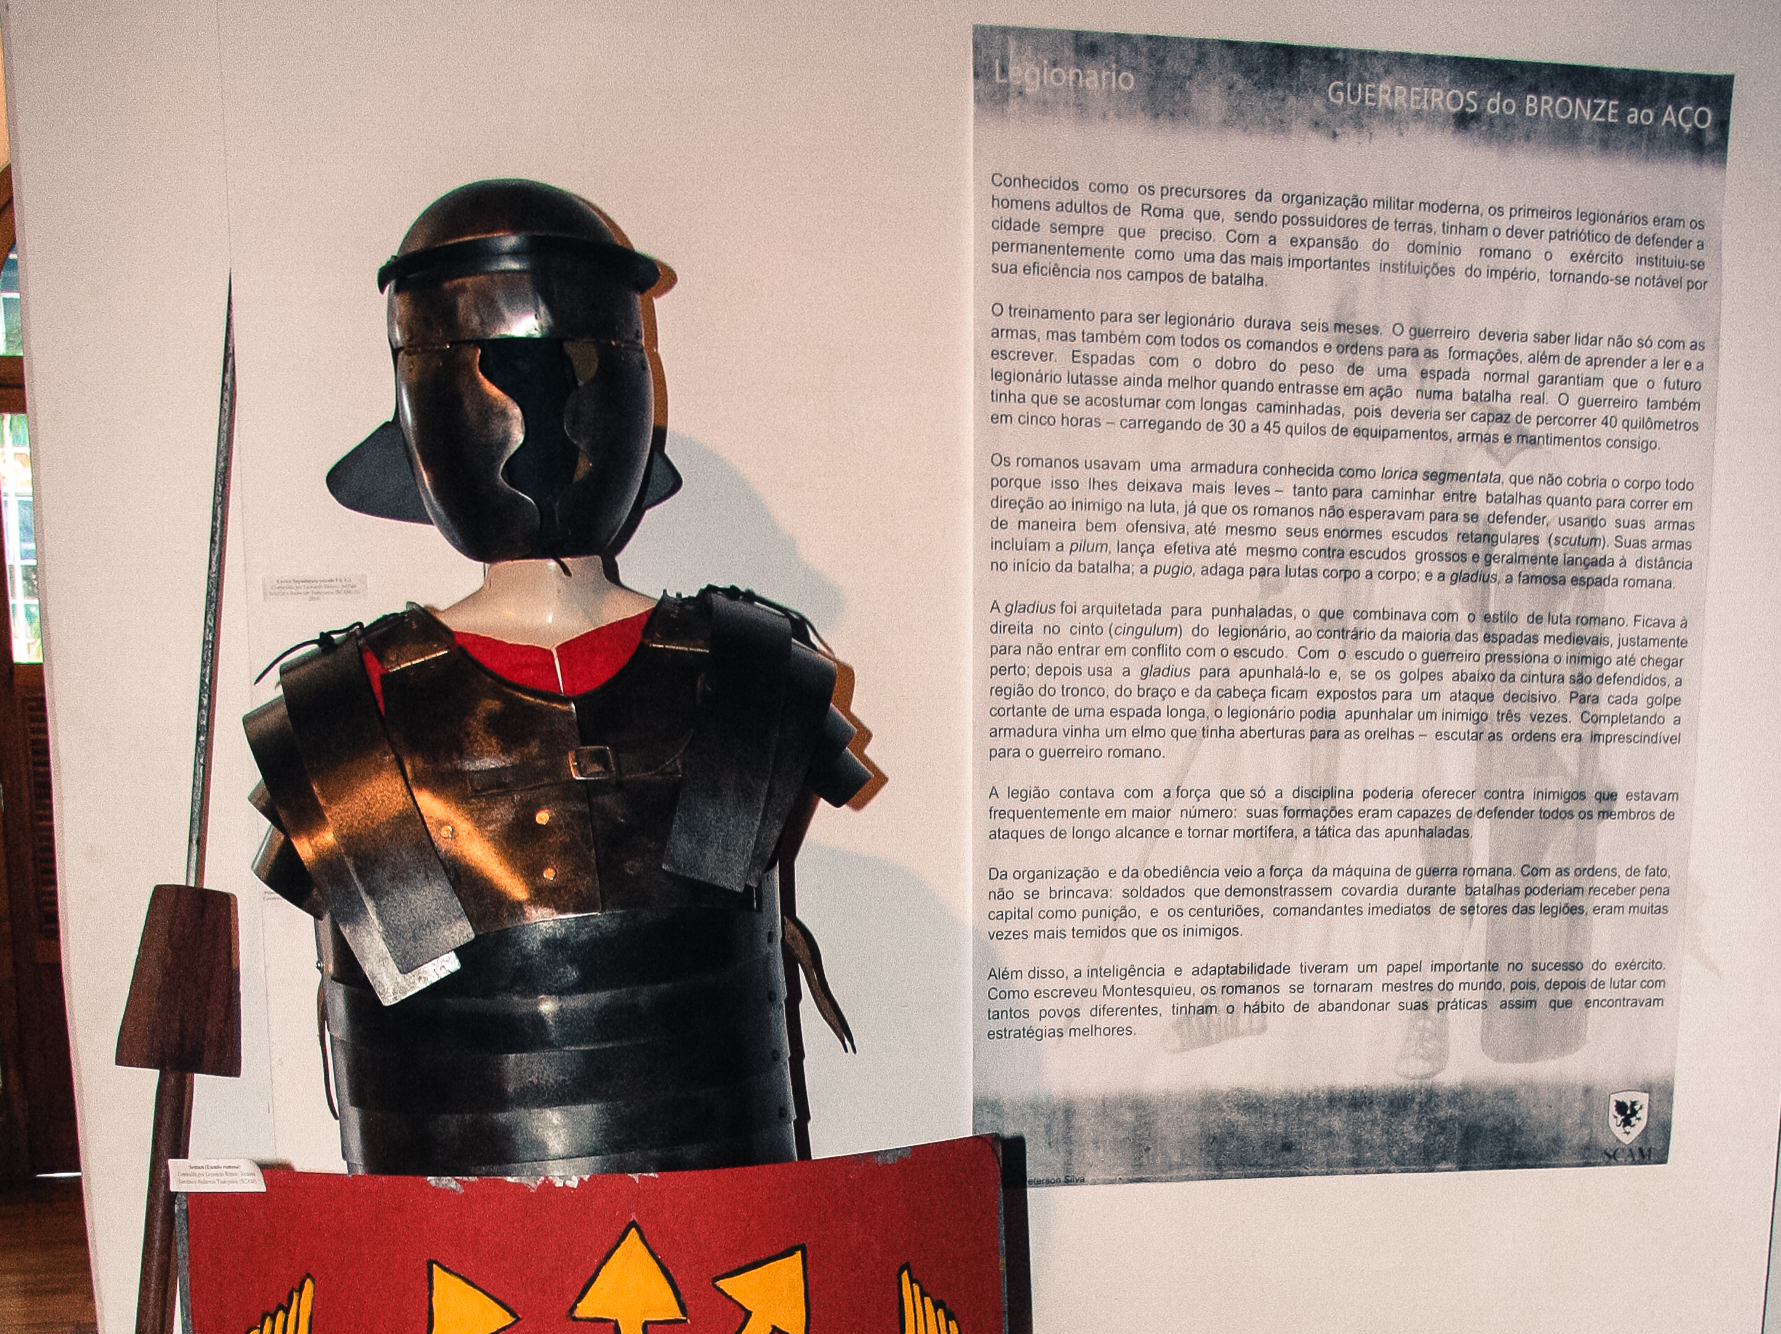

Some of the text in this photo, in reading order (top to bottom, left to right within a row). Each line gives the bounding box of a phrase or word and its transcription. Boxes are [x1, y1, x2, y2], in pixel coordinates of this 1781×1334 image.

[995, 57, 1135, 93] Legionario
[1328, 81, 1712, 131] GUERREIROS do BRONZE ao AÇO
[991, 171, 1705, 229] Conhecidos como os precursores da organização militar moderna, os primeiros legionários eram os
[991, 214, 1705, 269] cidade sempre que preciso. Com a expansão do domínio romano o exército instituiu-se
[991, 237, 1707, 293] permanentemente como uma das mais importantes instituições do império, tornando-se notável por
[990, 365, 1700, 412] legionário lutasse ainda melhor quando entrasse em ação numa batalha real. O guerreiro também
[990, 515, 1692, 551] de maneira bem ofensiva, até mesmo seus enormes escudos retangulares (scutum). Suas armas
[989, 619, 1688, 651] direita no cinto (cingulum) do legionário, ao contrário da maioria das espadas medievais, justamente
[988, 882, 1670, 900] não se brincava: soldados que demonstrassem covardia durante batalhas poderiam receber pena
[988, 901, 1668, 924] capital como punição, e os centuriões, comandantes imediatos de setores das legiões, eram muitas
[988, 923, 1242, 941] vezes mais temidos que os inimigos.
[987, 957, 1665, 981] Além disso, a inteligência e adaptabilidade tiveram um papel importante no sucesso do exército.
[987, 994, 1664, 1022] tantos povos diferentes, tinham o hábito de abandonar suas práticas assim que encontravam
[987, 1022, 1135, 1043] estratégias melhores.
[1027, 1175, 1086, 1186] eterson Silva
